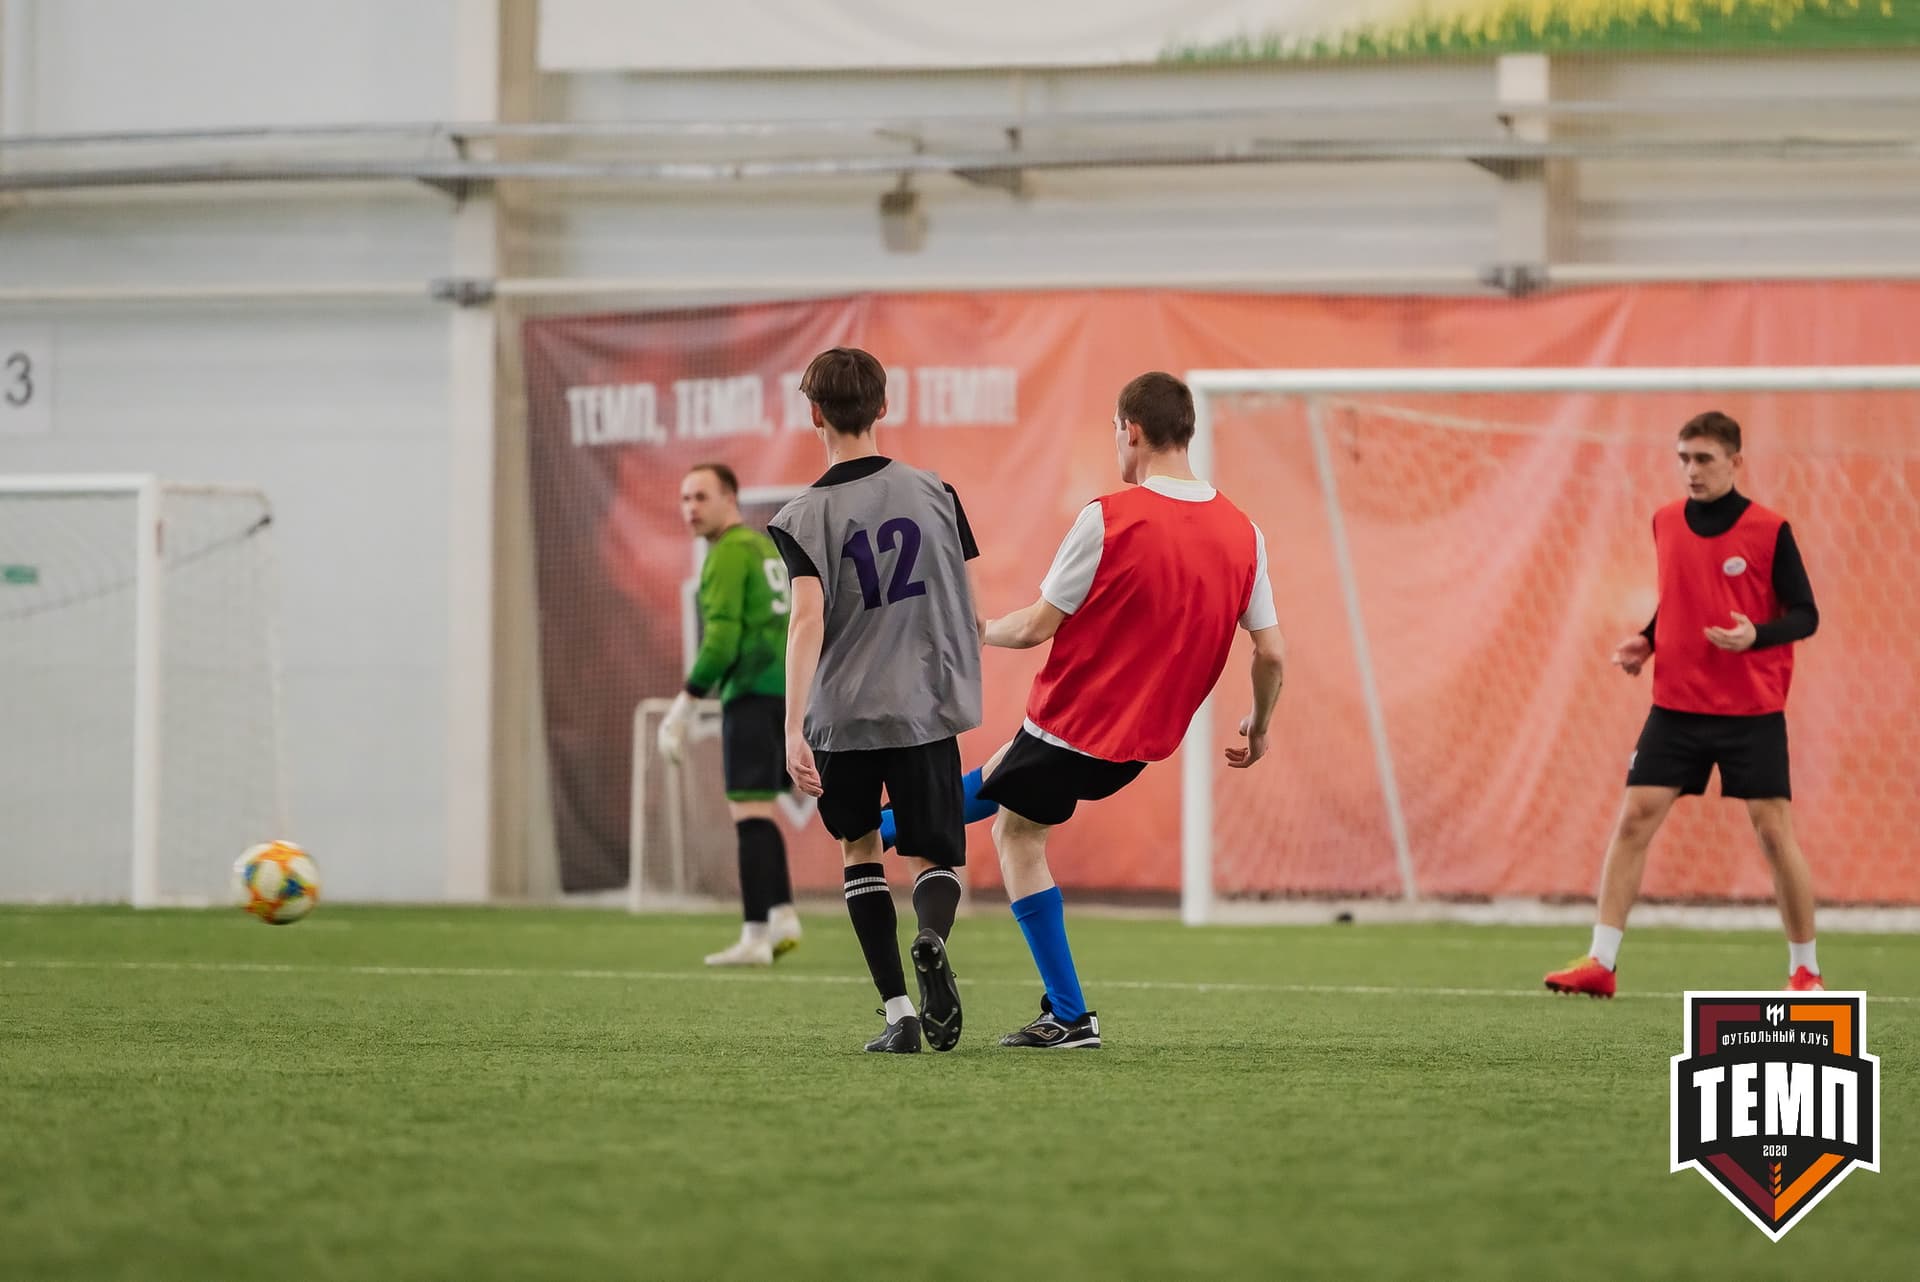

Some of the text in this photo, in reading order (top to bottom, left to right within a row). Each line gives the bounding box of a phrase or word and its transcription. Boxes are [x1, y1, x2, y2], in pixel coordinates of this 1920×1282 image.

[4, 351, 34, 407] 3
[566, 382, 667, 446] ТЕМП,
[673, 375, 775, 440] ТЕМП,
[841, 517, 927, 611] 12
